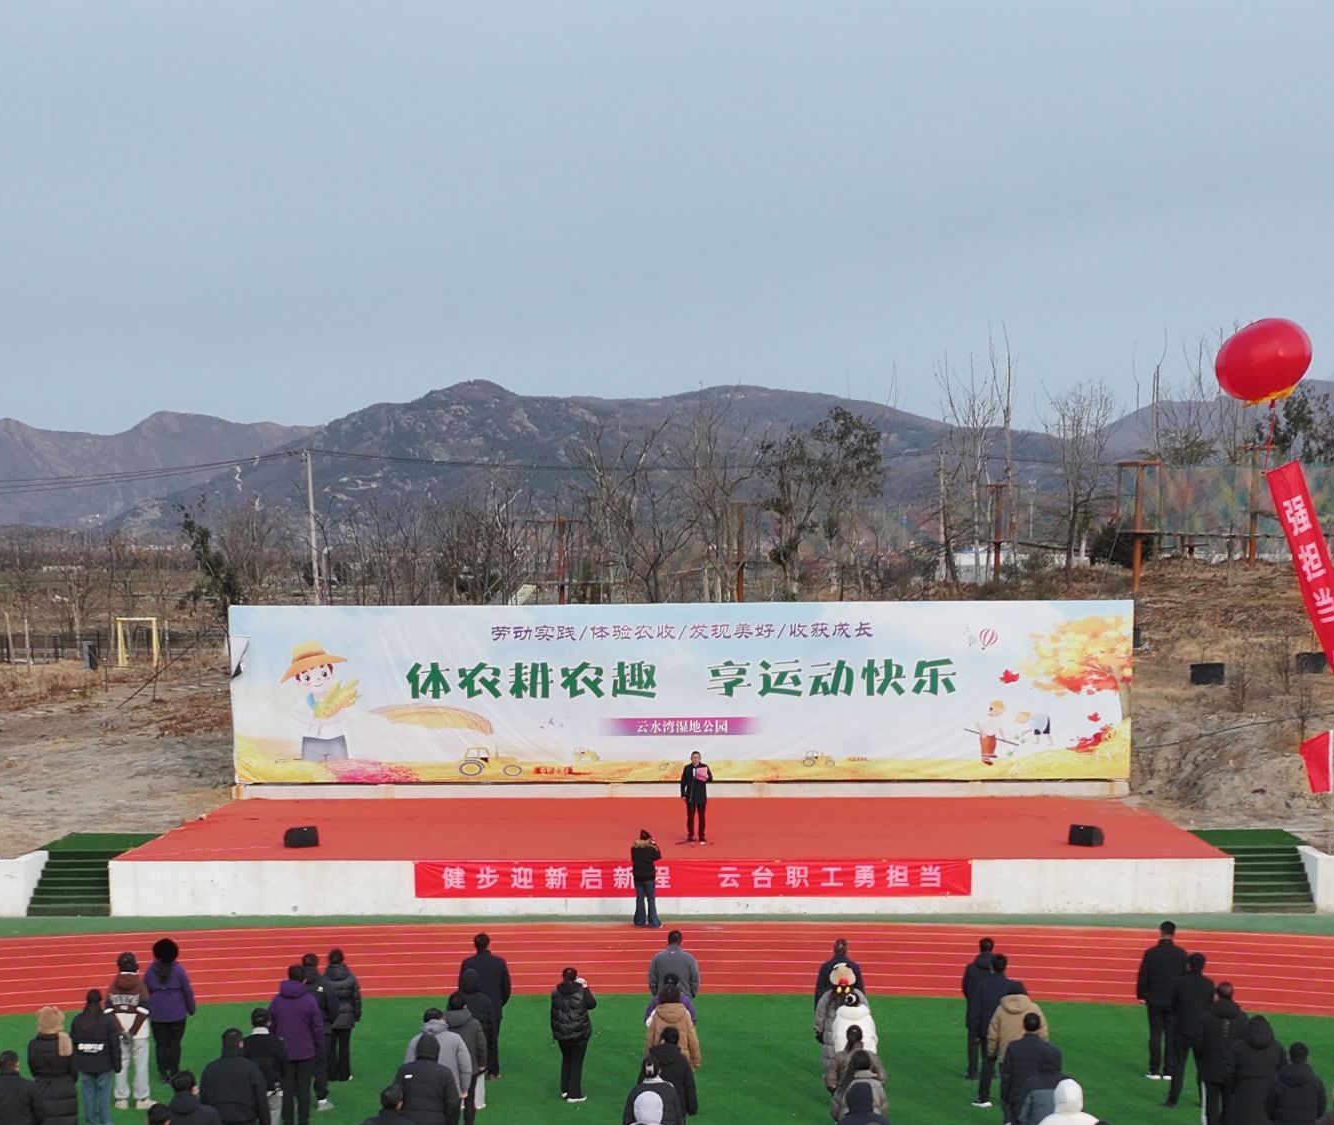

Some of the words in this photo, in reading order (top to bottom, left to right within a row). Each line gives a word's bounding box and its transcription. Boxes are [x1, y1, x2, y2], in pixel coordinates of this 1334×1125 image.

[405, 660, 657, 700] 体农耕农趣
[706, 657, 957, 699] 享运动快乐
[635, 719, 729, 734] 云水湾湿地公园
[717, 864, 942, 889] 云台职工勇担当
